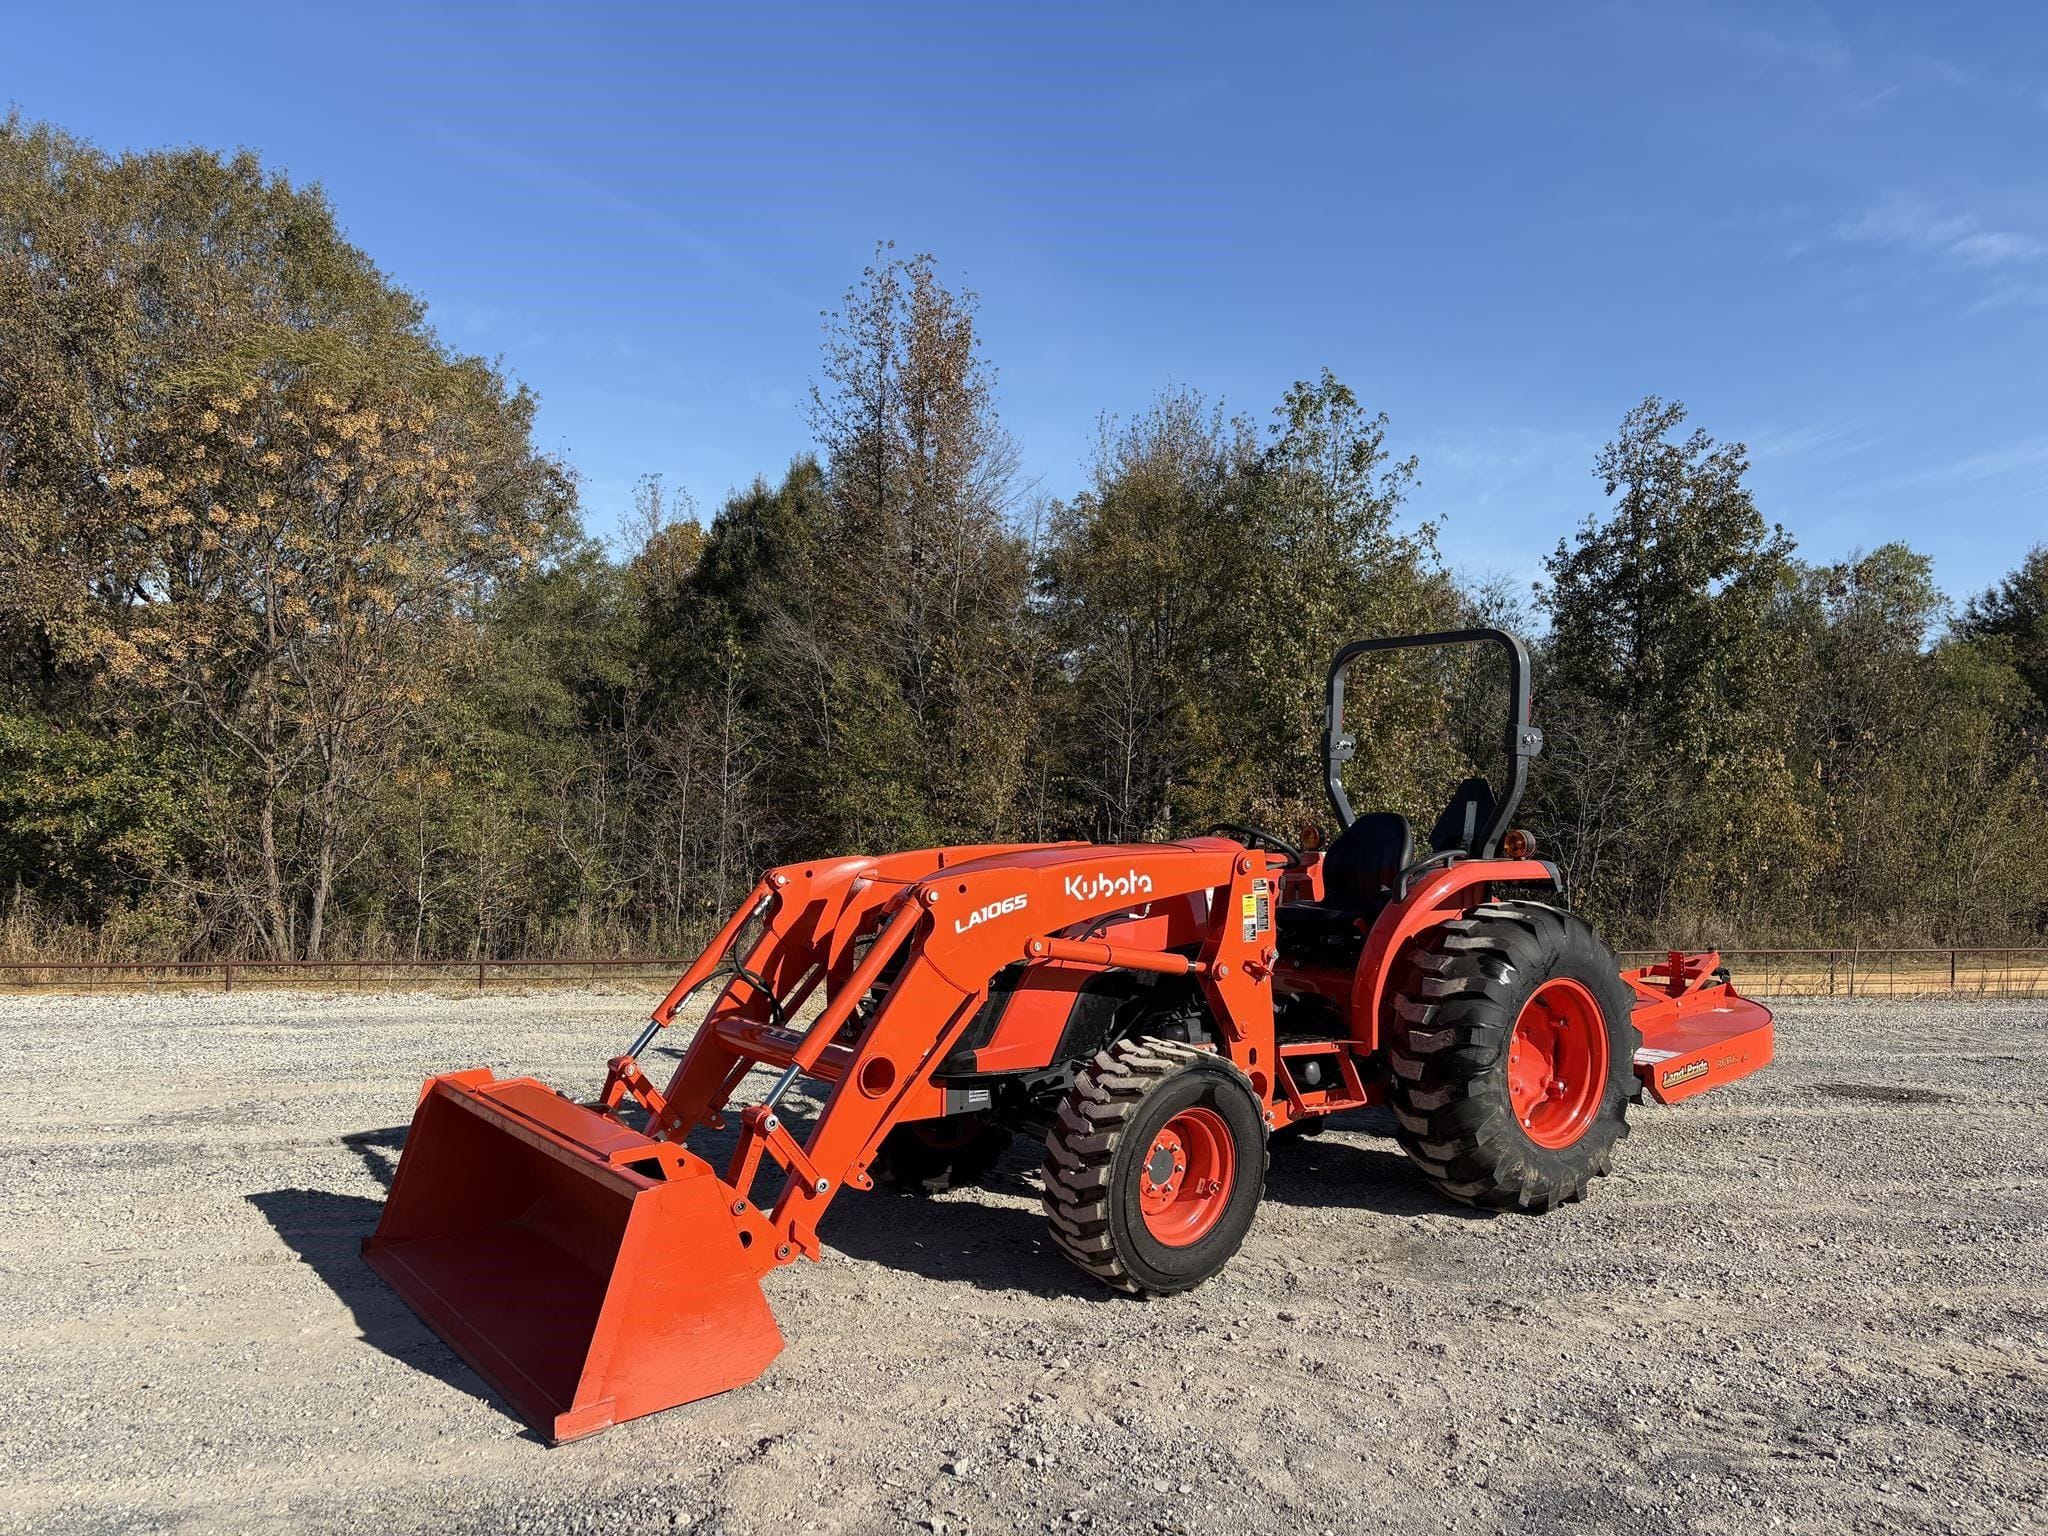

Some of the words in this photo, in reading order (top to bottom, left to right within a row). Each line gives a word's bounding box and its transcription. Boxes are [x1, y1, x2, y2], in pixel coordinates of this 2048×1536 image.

[1065, 869, 1152, 900] Kubota
[955, 893, 1028, 934] LA1065
[1663, 1066, 1685, 1082] Land
[1686, 1059, 1708, 1074] Pride
